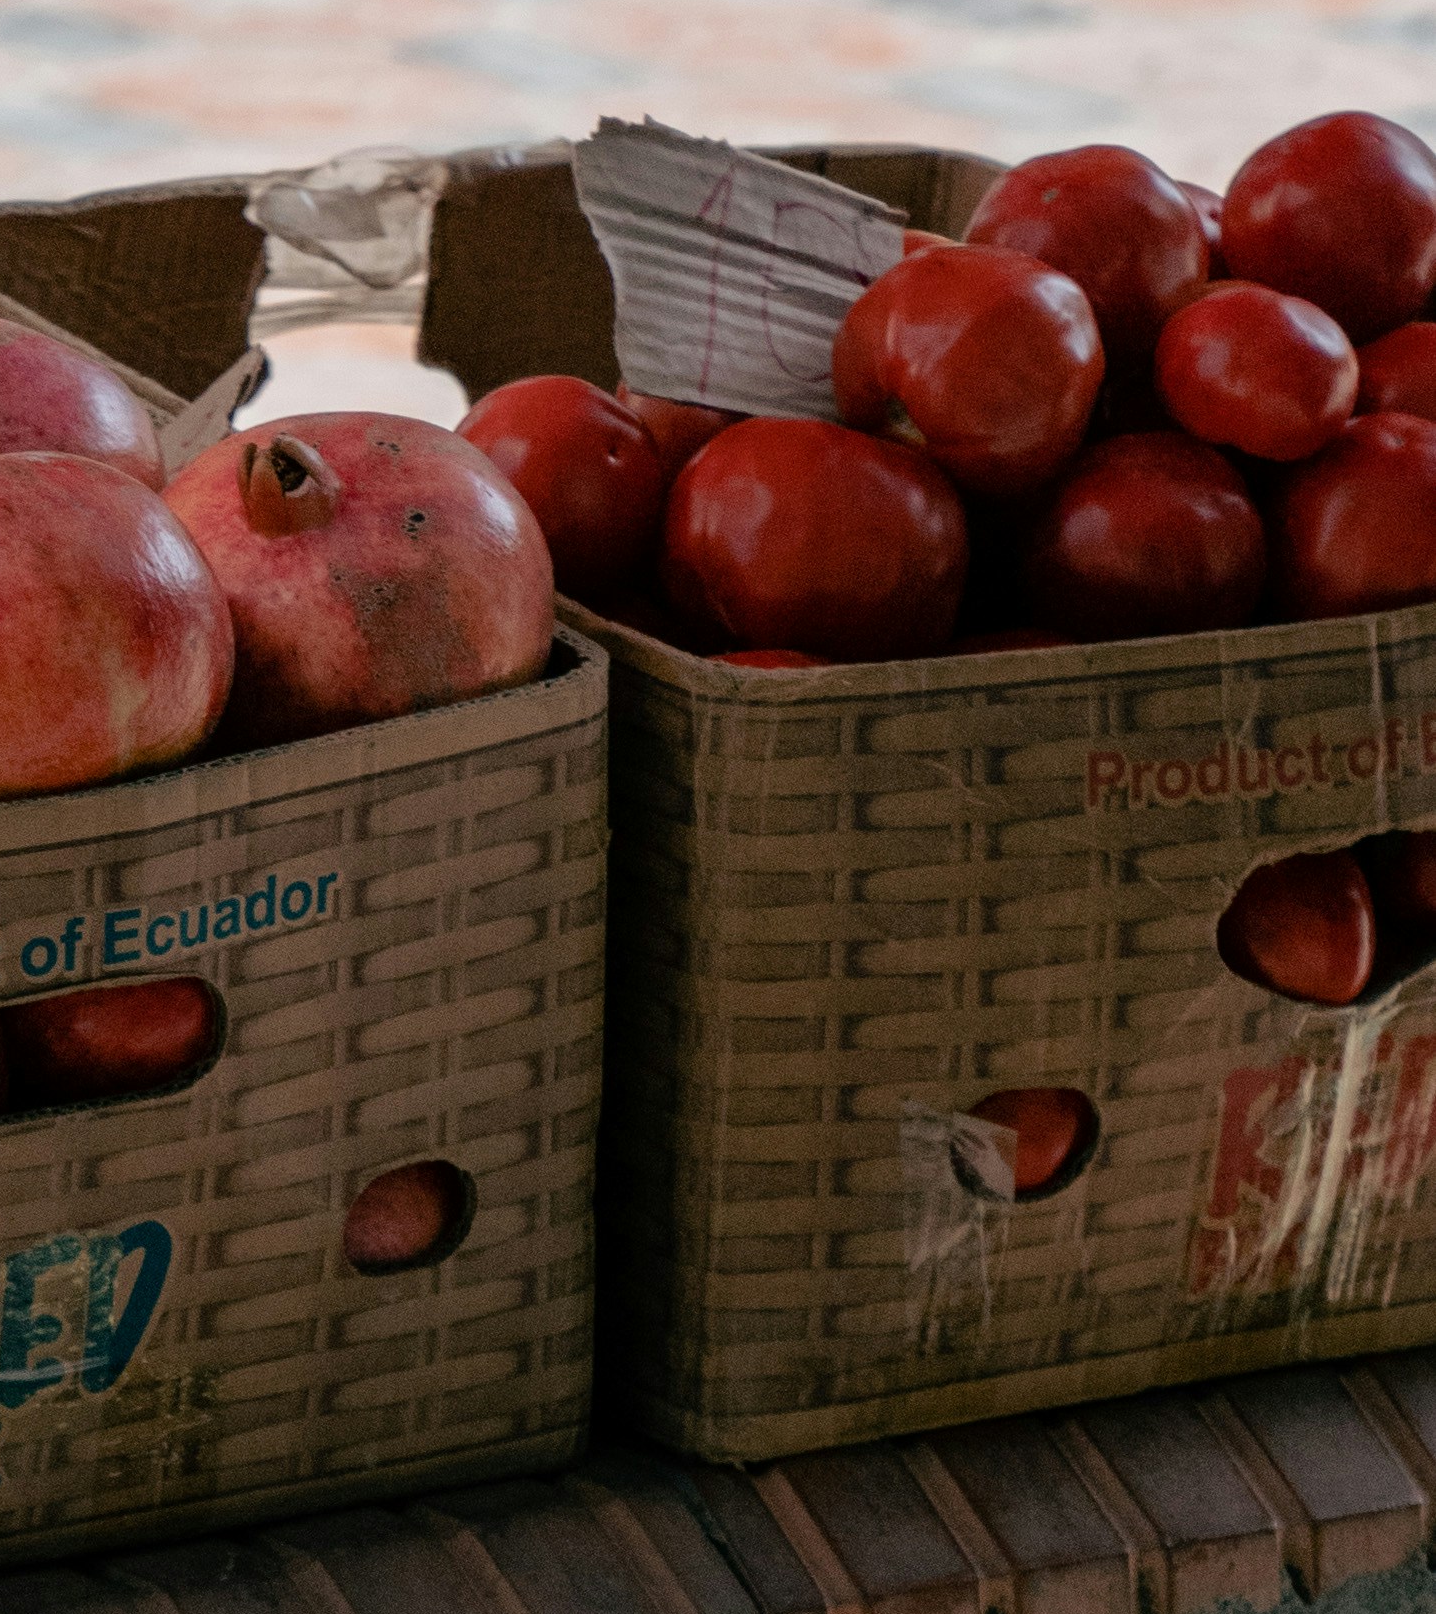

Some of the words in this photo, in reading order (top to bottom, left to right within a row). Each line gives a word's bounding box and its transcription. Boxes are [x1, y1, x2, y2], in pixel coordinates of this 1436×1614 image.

[1087, 733, 1329, 807] Product
[1347, 716, 1405, 779] of
[20, 917, 86, 978] of
[102, 871, 339, 966] Ecuador
